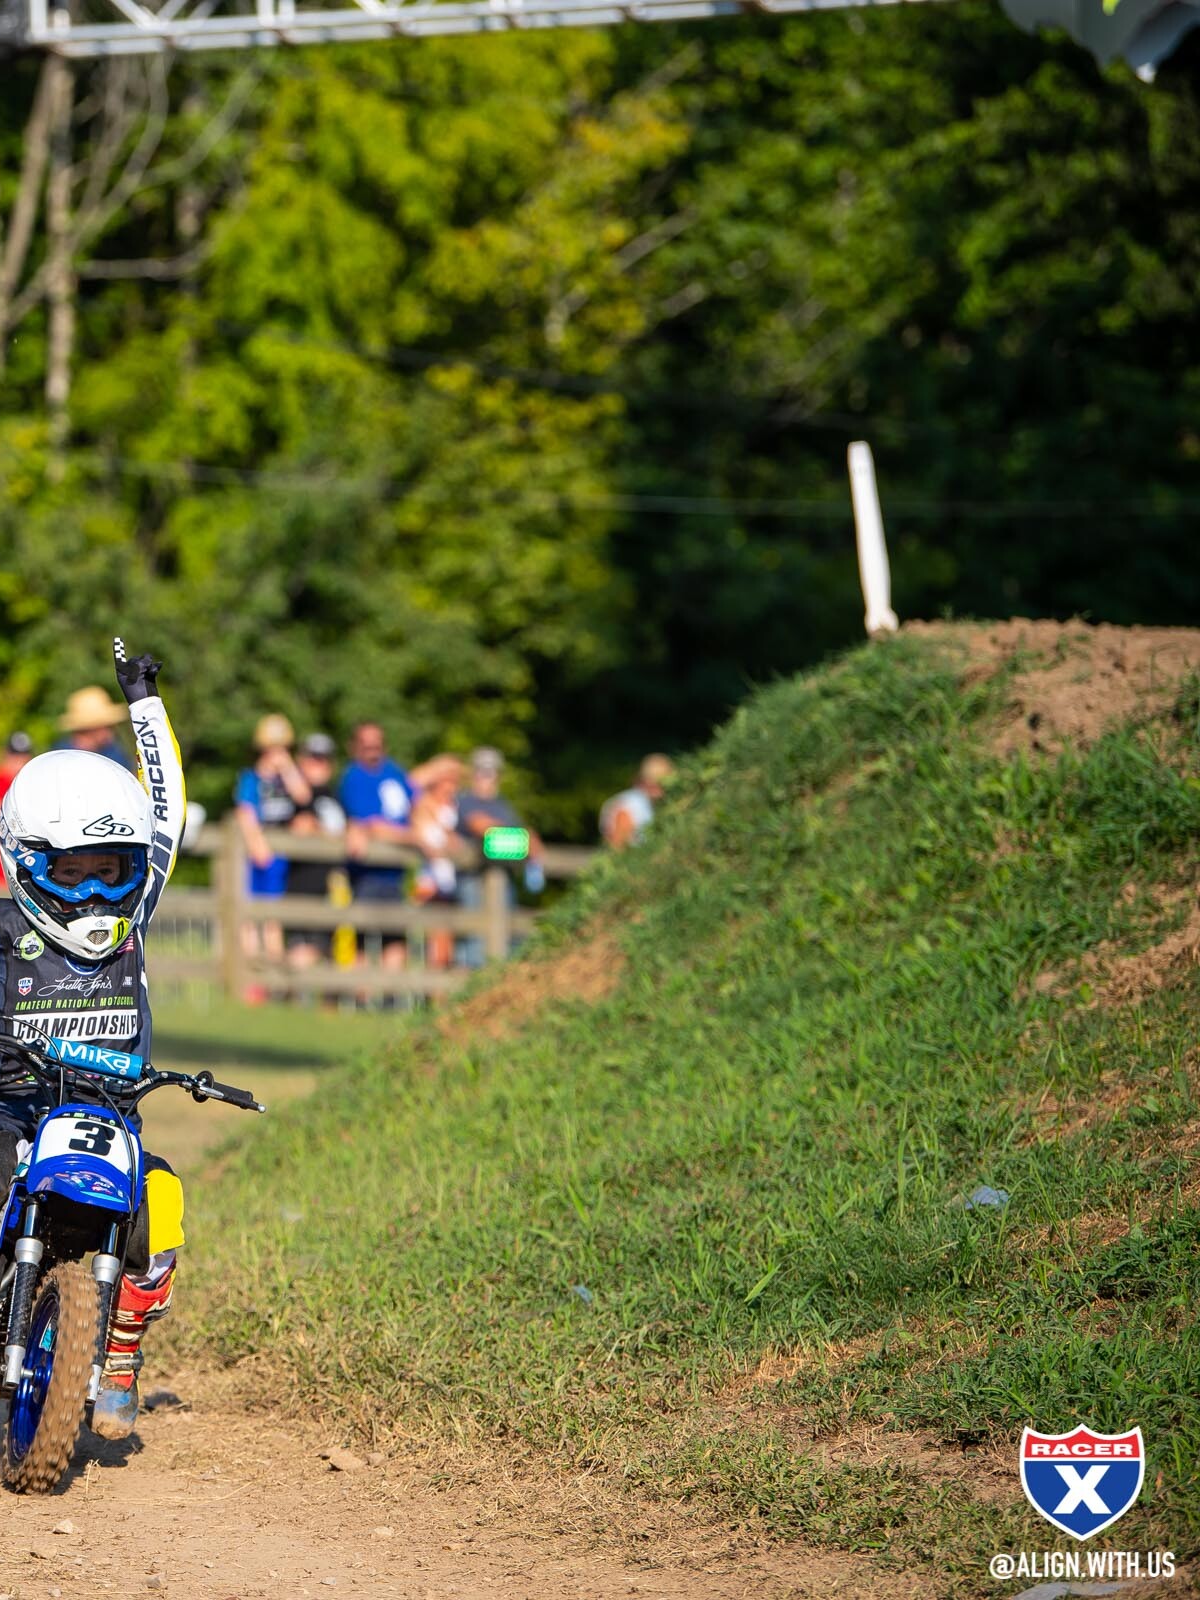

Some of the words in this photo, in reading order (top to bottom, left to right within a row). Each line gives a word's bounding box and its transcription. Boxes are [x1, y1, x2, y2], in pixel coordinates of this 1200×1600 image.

[82, 814, 135, 837] 6D
[15, 999, 52, 1011] AMATEUR
[55, 998, 95, 1009] NATIONAL
[18, 1014, 137, 1039] CHAMPIONSHIP
[60, 1041, 131, 1071] Mika
[68, 1121, 116, 1156] 3
